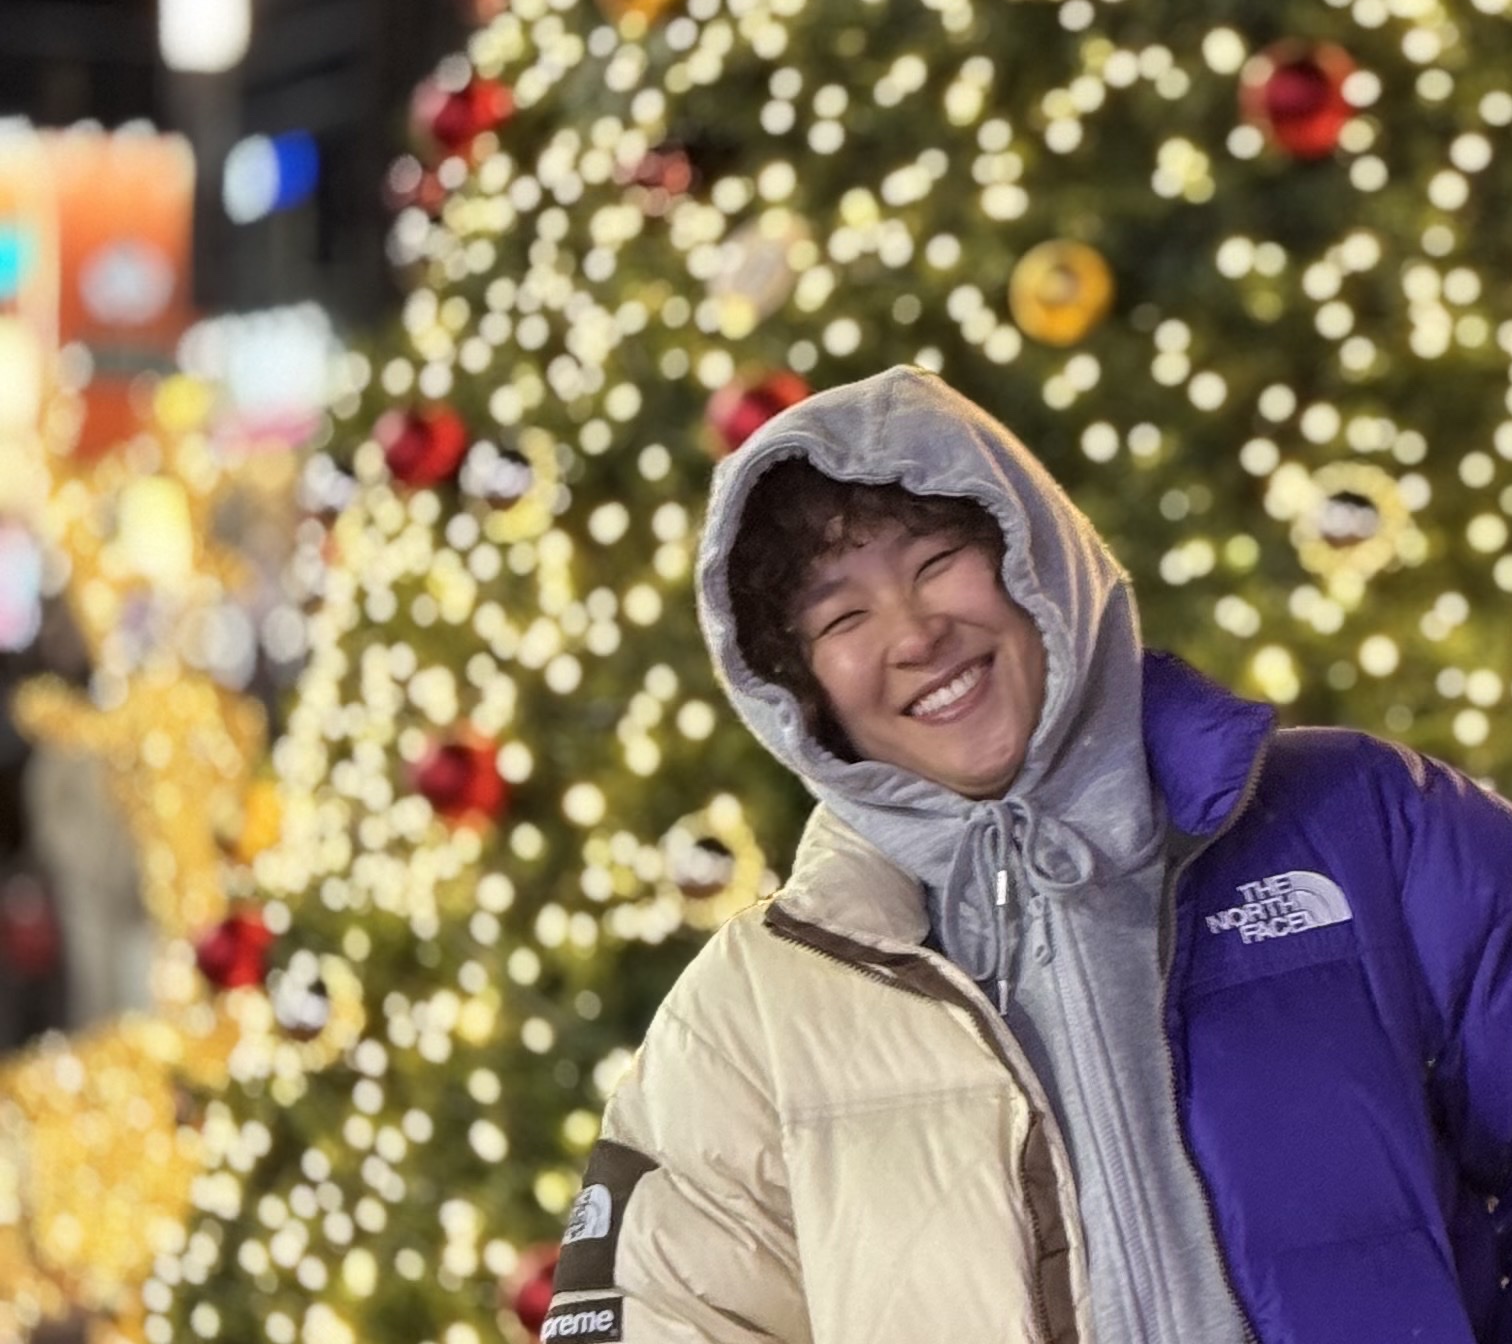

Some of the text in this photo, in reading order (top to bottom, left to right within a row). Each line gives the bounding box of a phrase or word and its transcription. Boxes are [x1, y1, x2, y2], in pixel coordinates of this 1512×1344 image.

[1236, 875, 1292, 902] THE
[1205, 893, 1298, 934] NORTH
[1239, 910, 1311, 944] FACE
